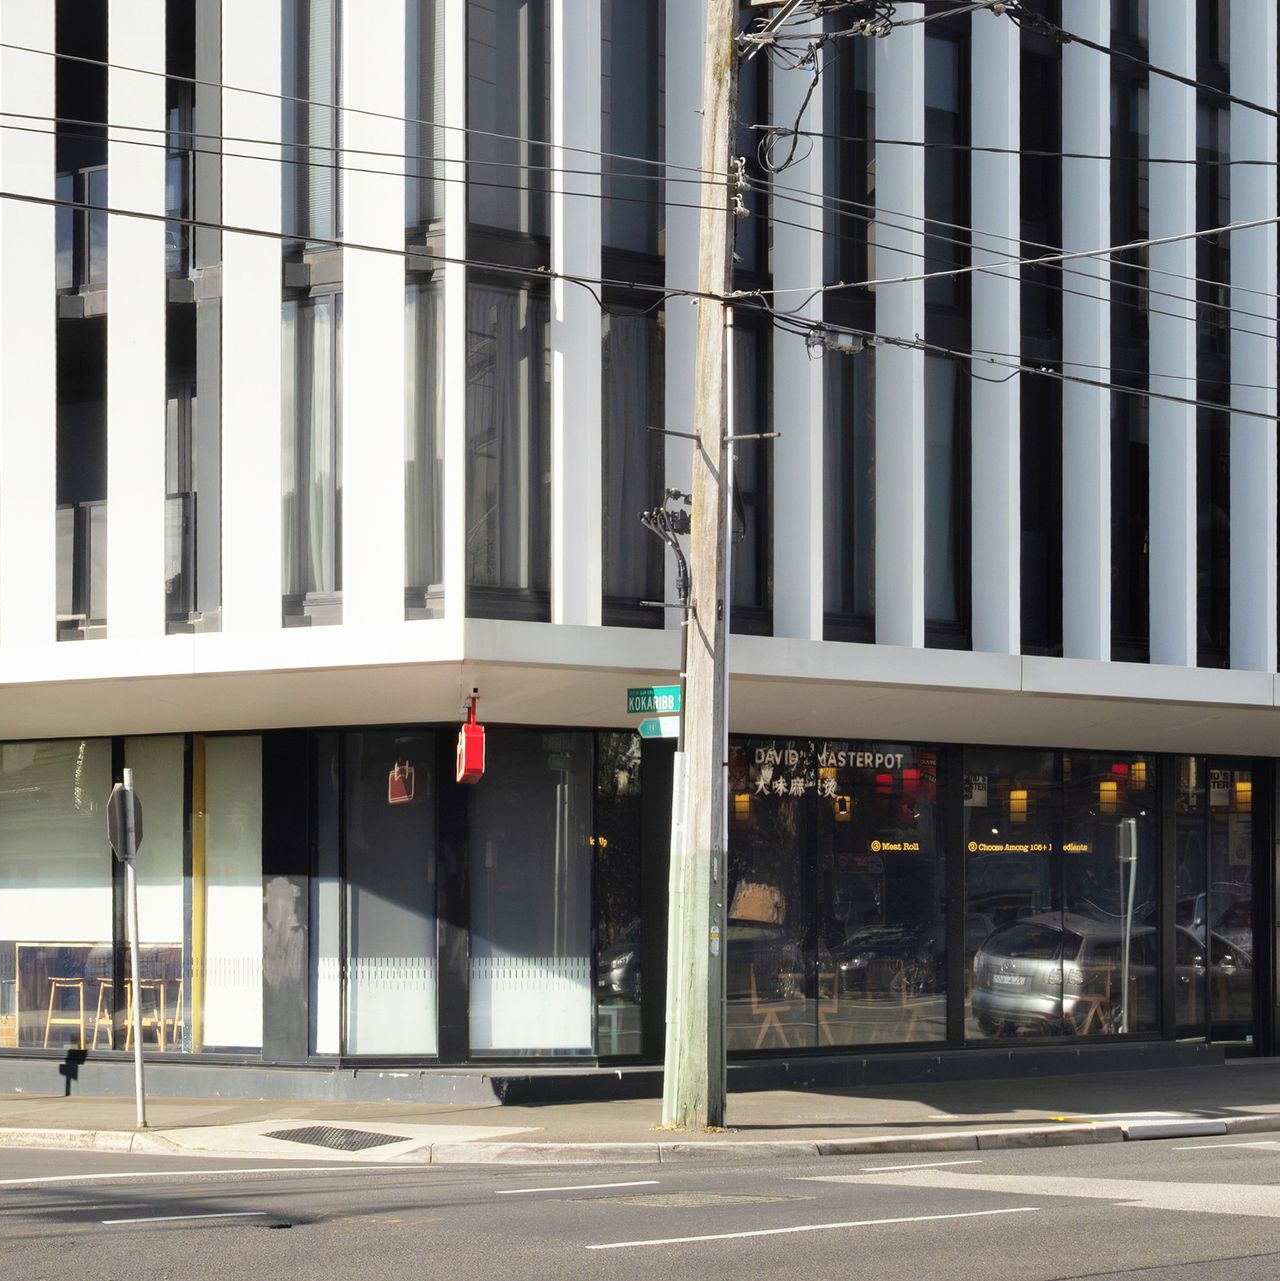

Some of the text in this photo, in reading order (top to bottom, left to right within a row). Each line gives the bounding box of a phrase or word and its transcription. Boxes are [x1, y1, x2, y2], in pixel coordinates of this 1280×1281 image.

[628, 694, 674, 711] KOKARIBB
[755, 748, 813, 765] DAVID'
[755, 775, 838, 798] 大味麻烫
[881, 842, 902, 851] Meat
[902, 842, 919, 851] Roll
[978, 842, 1003, 851] Choose
[1003, 843, 1028, 852] Among
